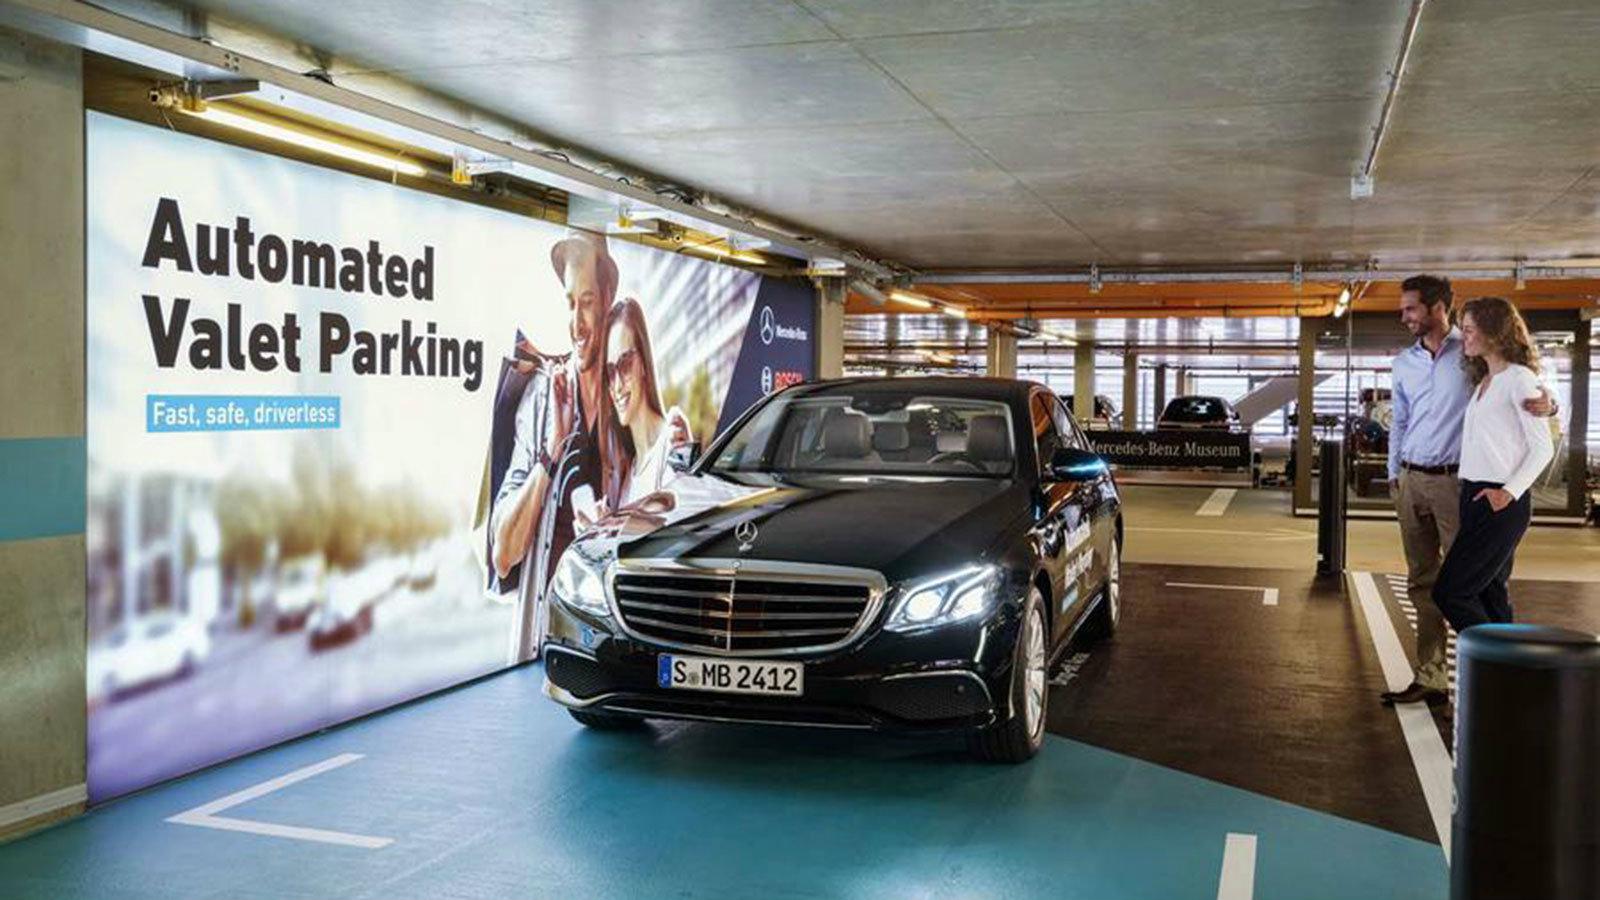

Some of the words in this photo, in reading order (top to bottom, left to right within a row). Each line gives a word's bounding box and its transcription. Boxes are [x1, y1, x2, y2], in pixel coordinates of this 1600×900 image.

[141, 196, 435, 301] Automated
[141, 295, 301, 372] Valet
[319, 311, 484, 392] Parking
[153, 401, 200, 427] Fast,
[206, 401, 250, 427] safe,
[254, 401, 337, 424] driverless
[1184, 441, 1241, 457] Museum
[673, 660, 687, 684] S
[702, 662, 731, 688] MB
[736, 665, 798, 692] 2412
